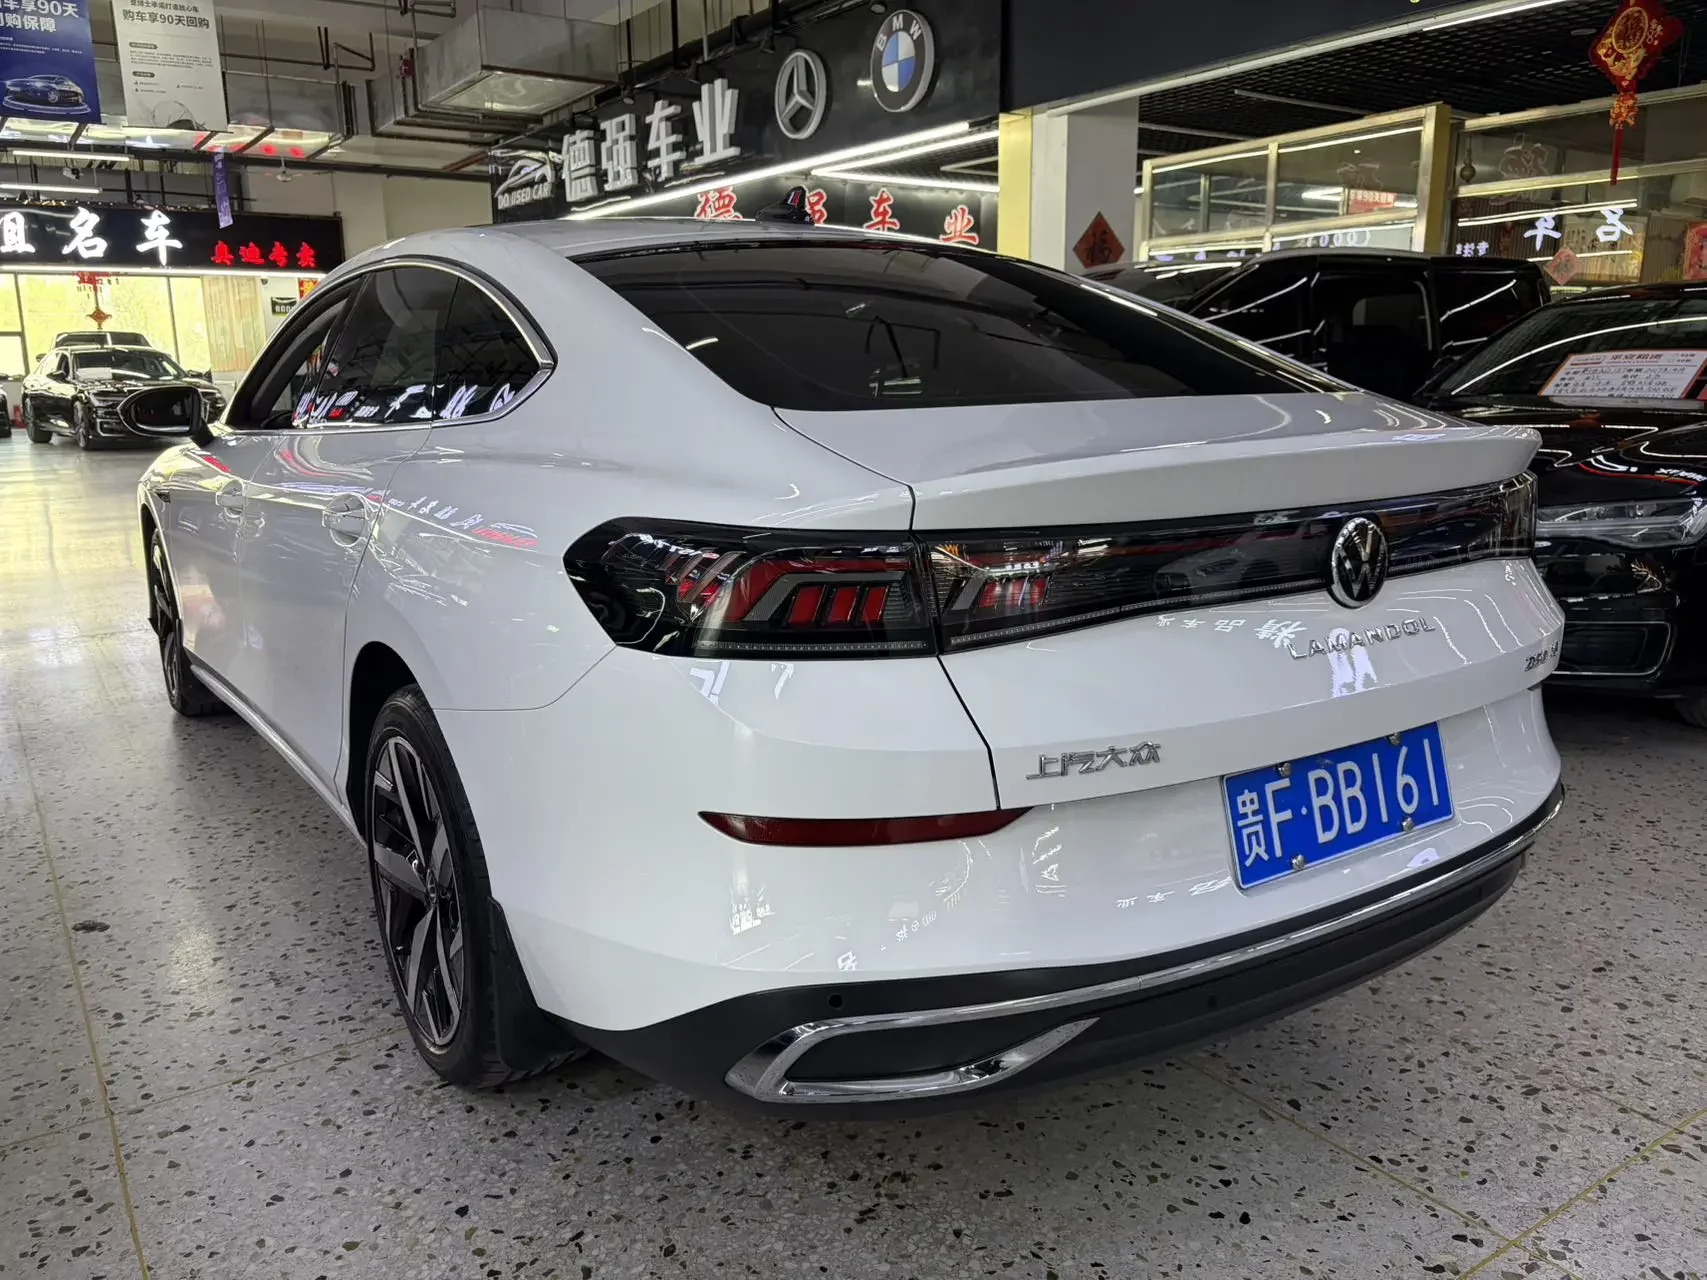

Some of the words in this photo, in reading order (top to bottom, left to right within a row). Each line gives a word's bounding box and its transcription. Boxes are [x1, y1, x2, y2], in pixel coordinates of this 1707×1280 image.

[0, 0, 79, 18] 车享90天
[122, 9, 209, 29] 购车享90天回购
[876, 13, 922, 51] BMW
[562, 79, 741, 202] 德强车业
[1287, 616, 1435, 659] LAMANDOL
[1025, 741, 1161, 780] 上汽大众
